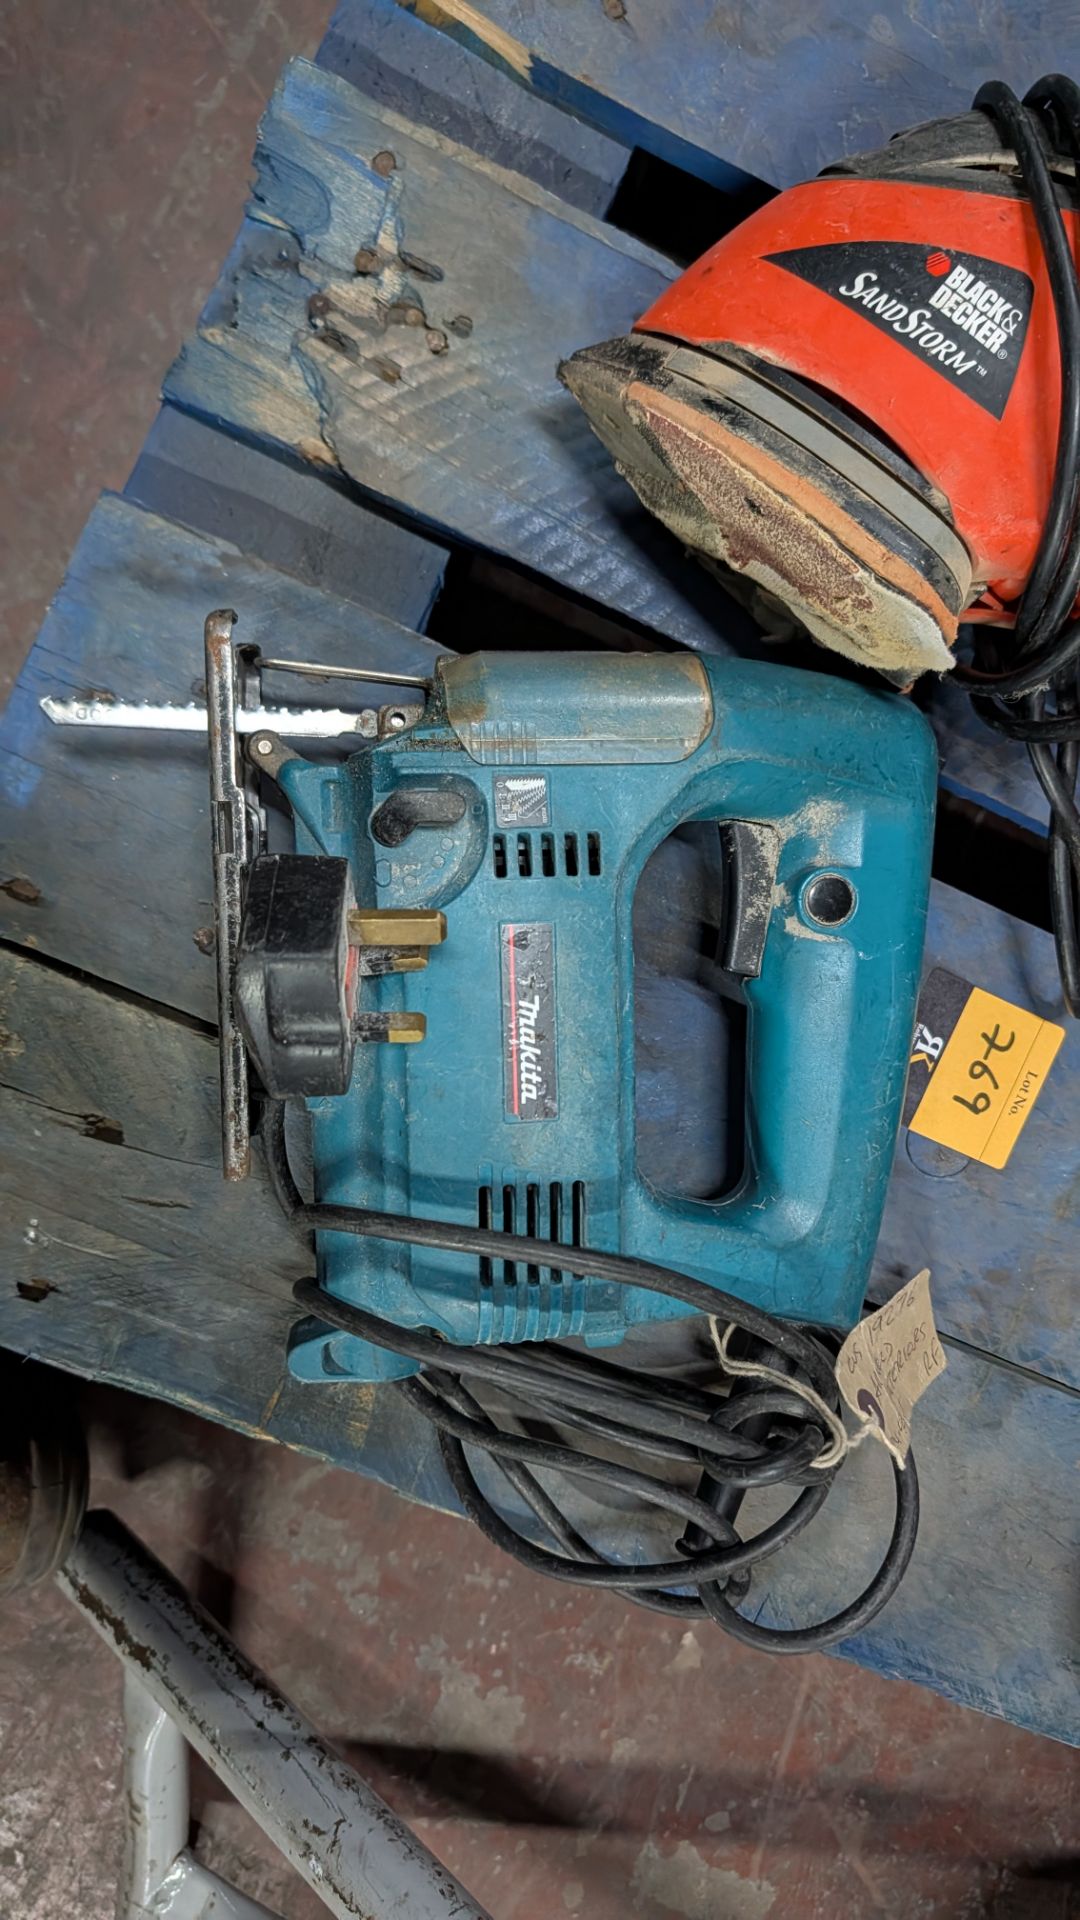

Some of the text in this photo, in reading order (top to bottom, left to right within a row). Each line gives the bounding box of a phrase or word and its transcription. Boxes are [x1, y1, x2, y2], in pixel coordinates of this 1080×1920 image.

[952, 1024, 1016, 1115] 769
[1008, 1069, 1039, 1117] Lot No.
